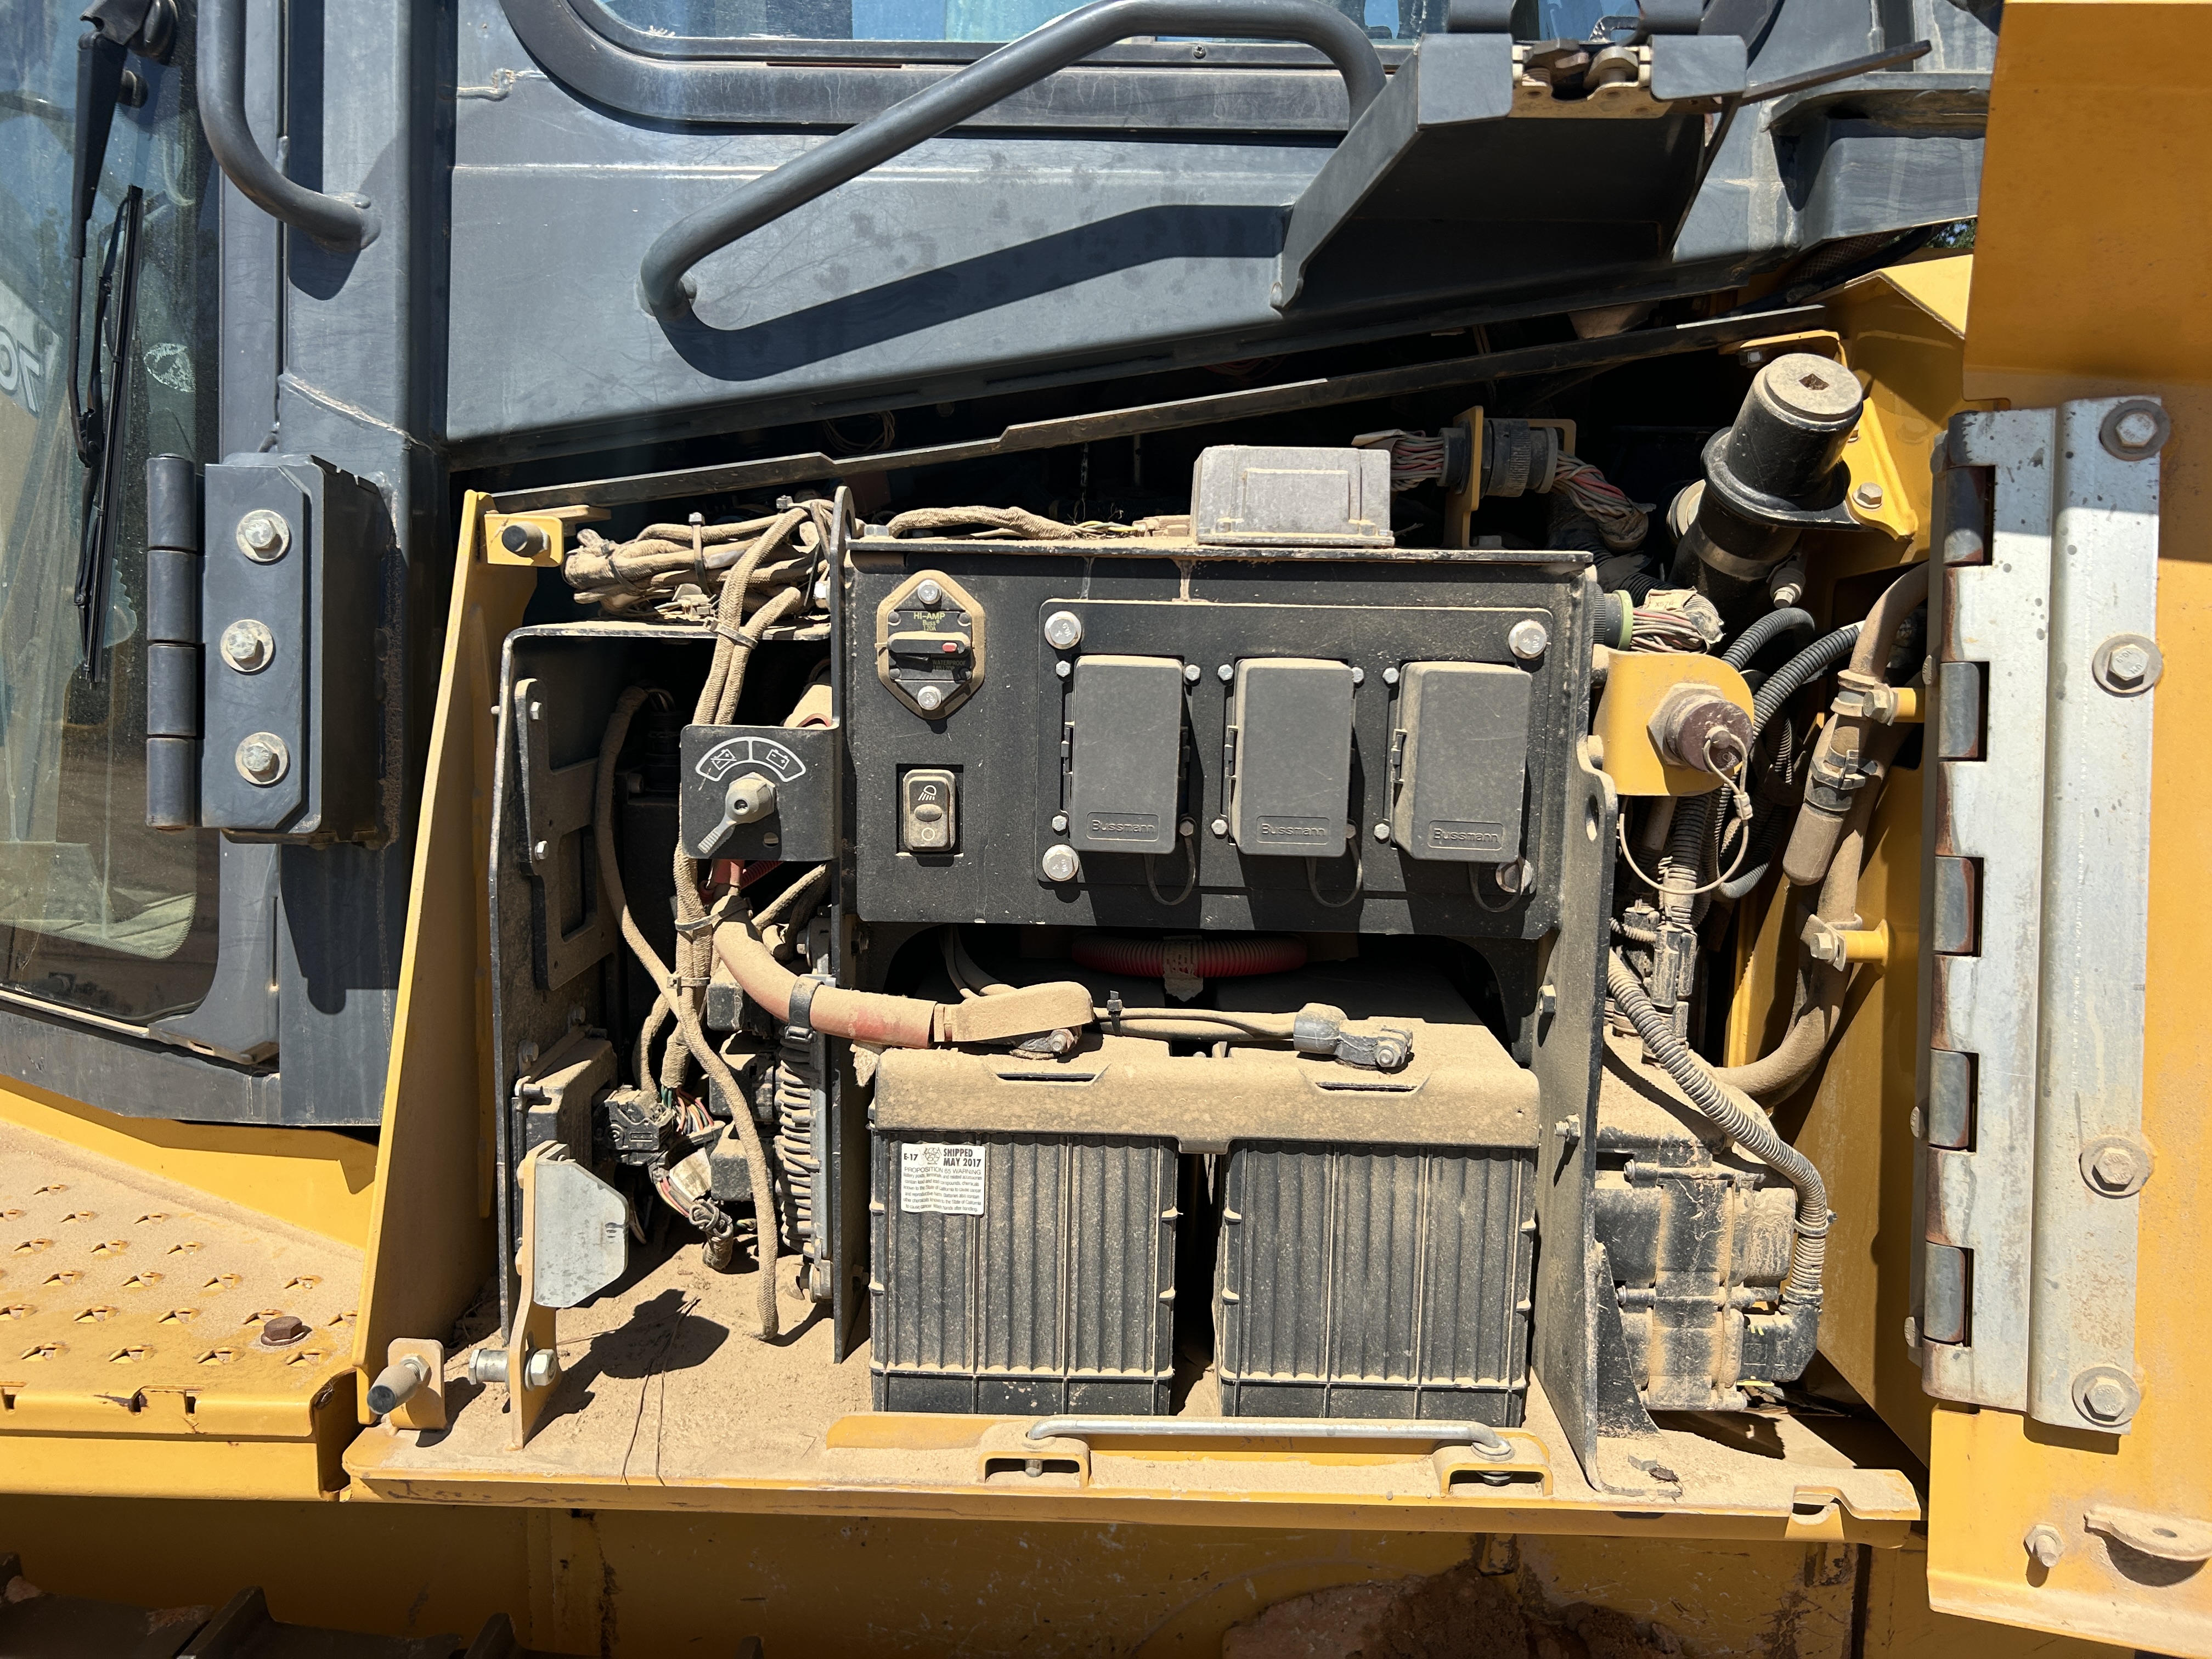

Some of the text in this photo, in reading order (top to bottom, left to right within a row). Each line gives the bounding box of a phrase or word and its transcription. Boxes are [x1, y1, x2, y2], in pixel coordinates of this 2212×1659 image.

[913, 612, 946, 620] HI-AMP
[1092, 820, 1155, 833] Bussmann
[1261, 823, 1327, 837] Bussmann
[1433, 827, 1499, 843] Bussmann
[943, 1148, 973, 1157] SHIPPED
[943, 1157, 981, 1167] MAY 2017
